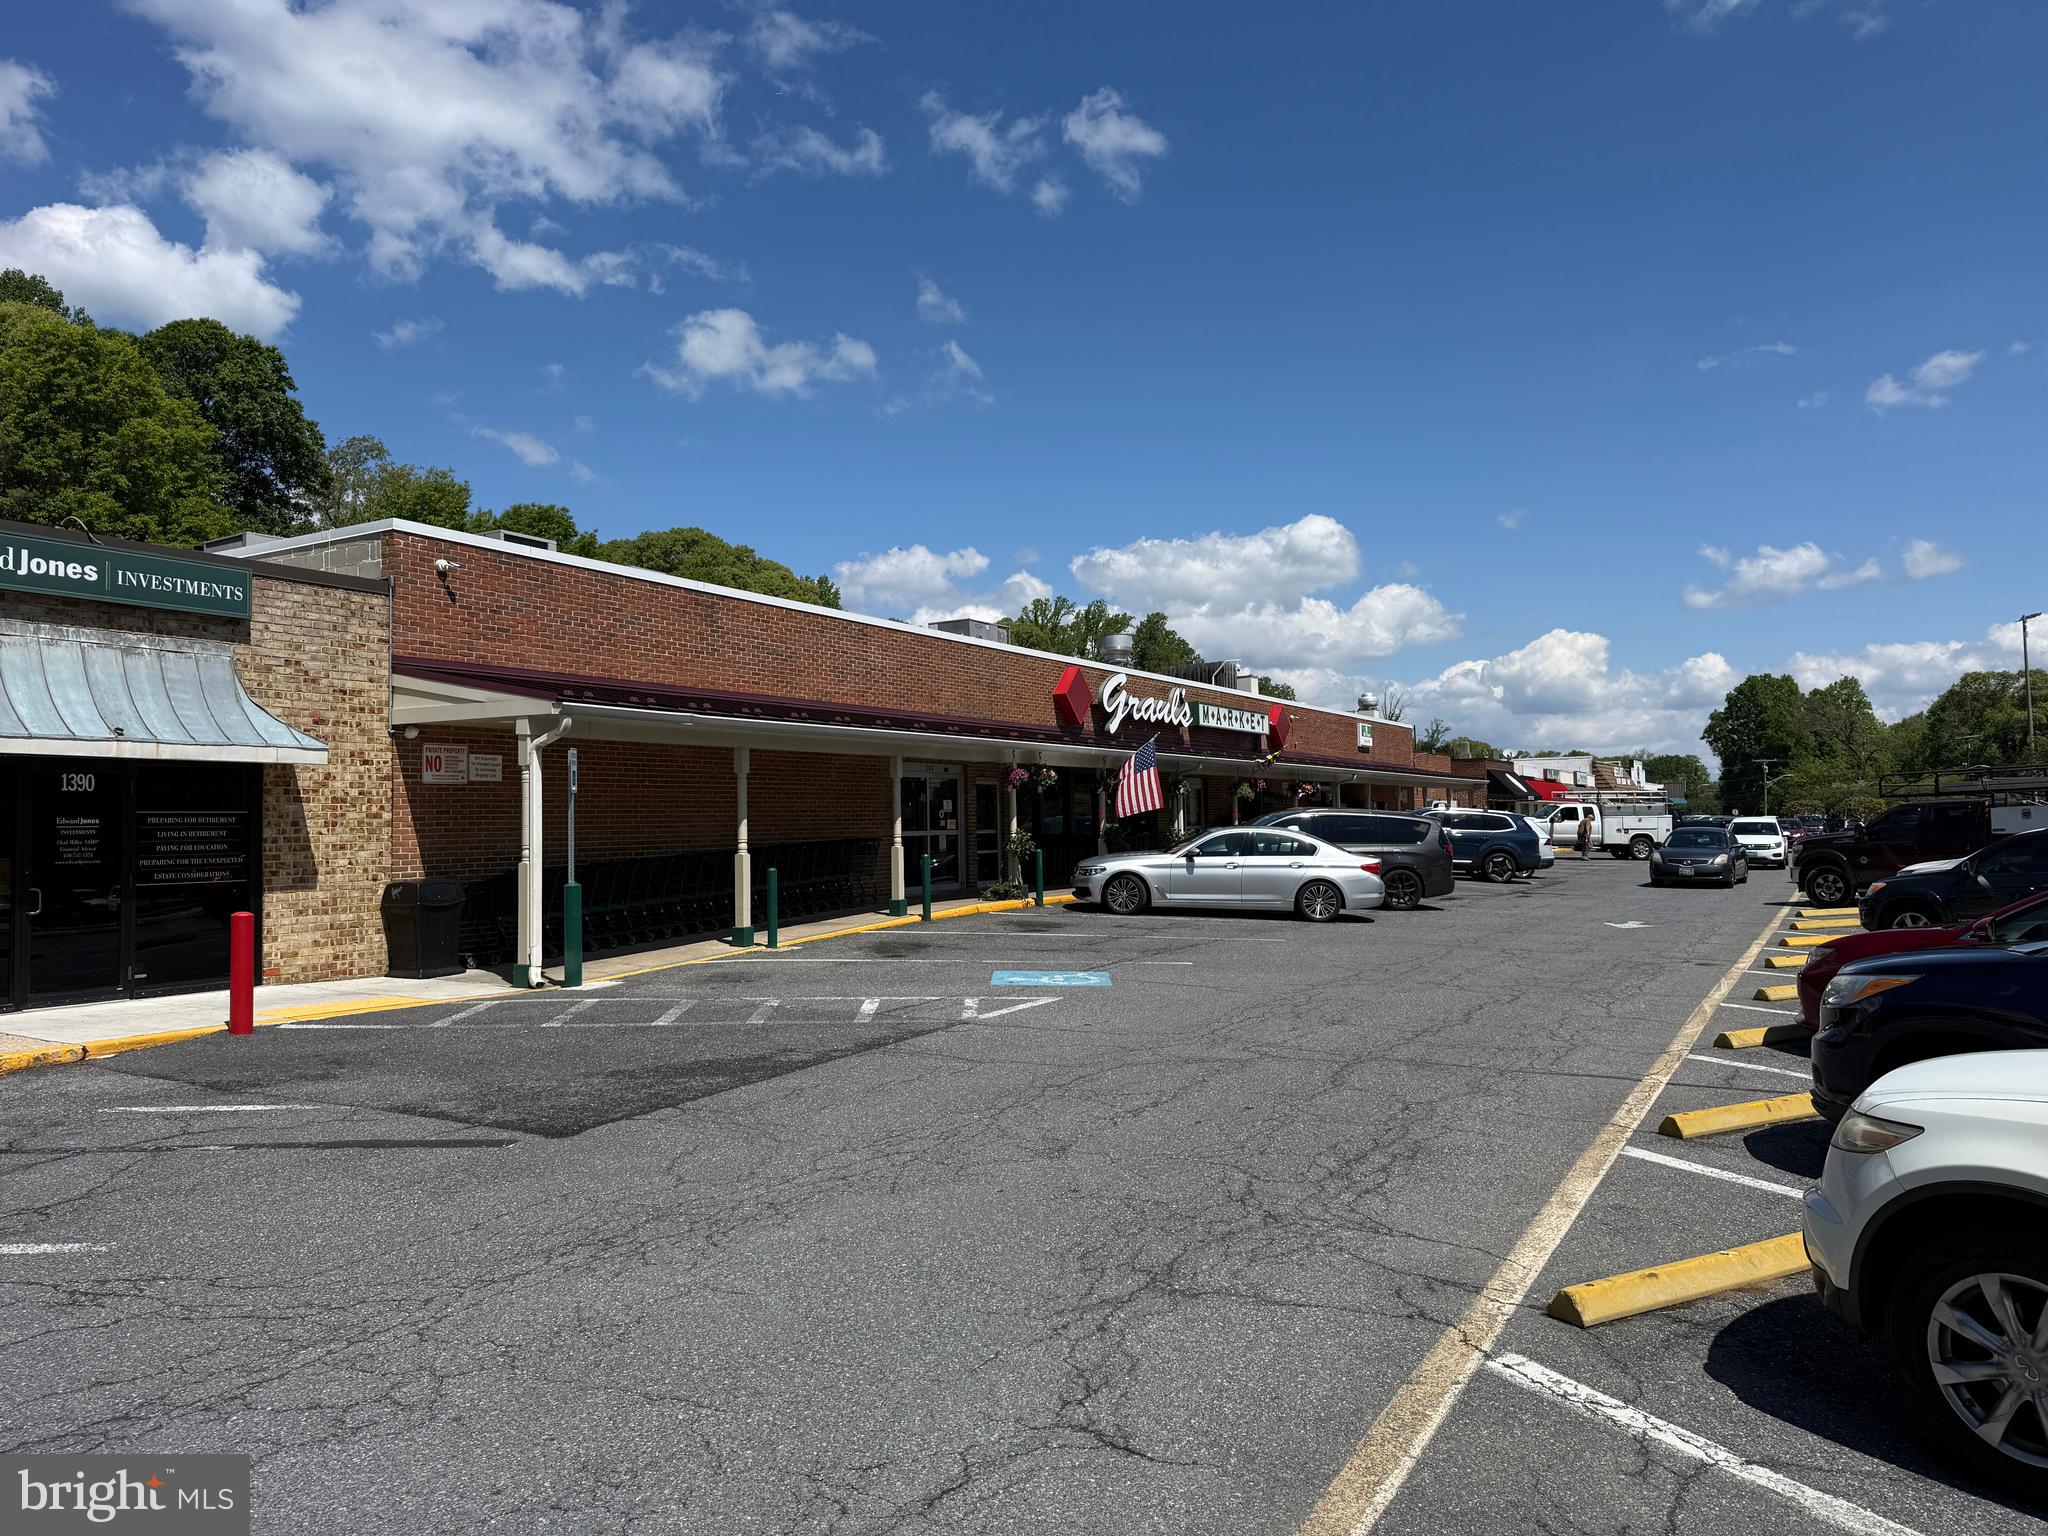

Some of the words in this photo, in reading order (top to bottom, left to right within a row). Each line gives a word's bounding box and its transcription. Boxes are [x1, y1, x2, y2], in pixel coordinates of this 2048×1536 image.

[117, 569, 243, 601] INVESTMENTS
[1101, 673, 1193, 735] Graul's
[425, 755, 441, 772] NO
[61, 773, 95, 791] 1390
[139, 859, 175, 867] PREPARING
[154, 872, 177, 880] ESTATE
[177, 871, 230, 879] CONSIDERATIONS
